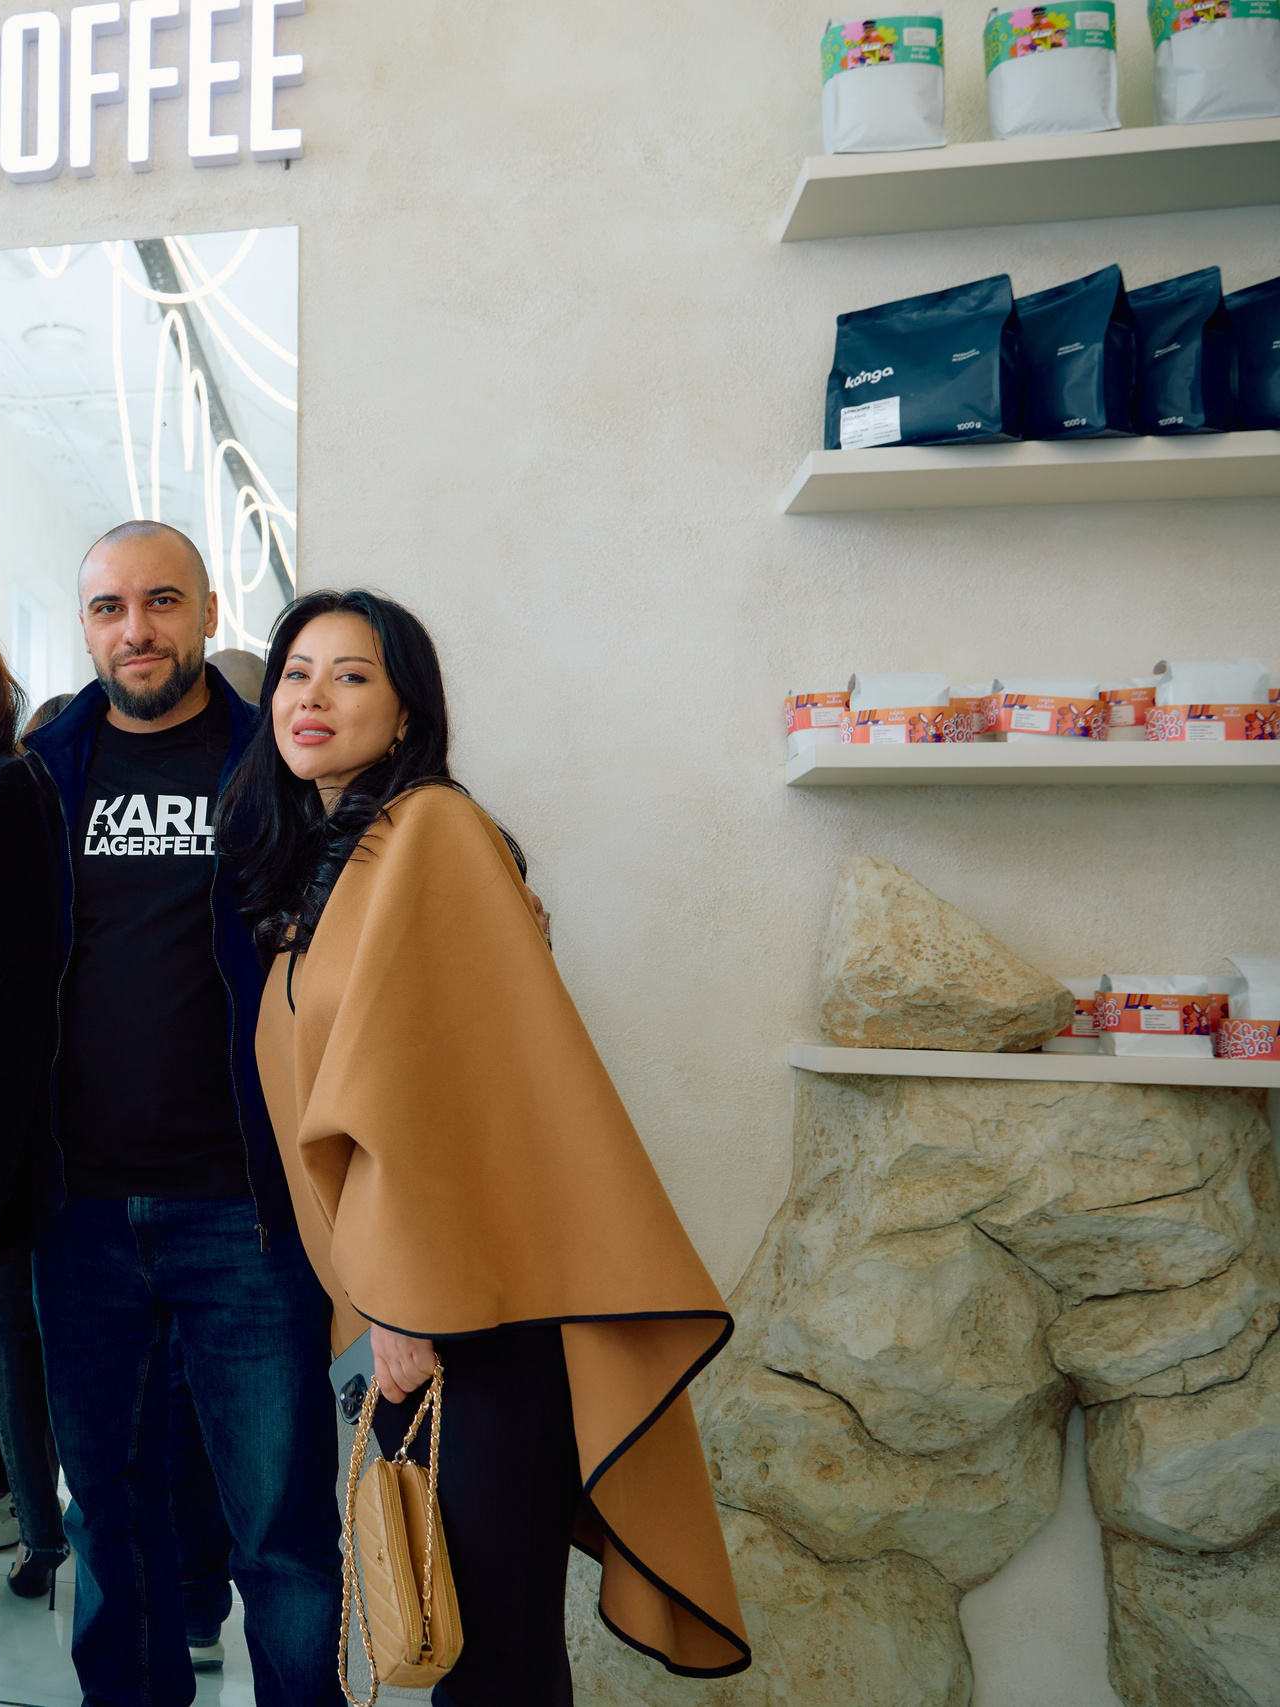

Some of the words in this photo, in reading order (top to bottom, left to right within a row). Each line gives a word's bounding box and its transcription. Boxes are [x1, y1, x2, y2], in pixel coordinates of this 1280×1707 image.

[844, 366, 894, 389] kanga
[956, 421, 975, 431] 1000
[1063, 418, 1080, 428] 1000
[1157, 416, 1177, 427] 1000
[87, 794, 216, 836] KARL
